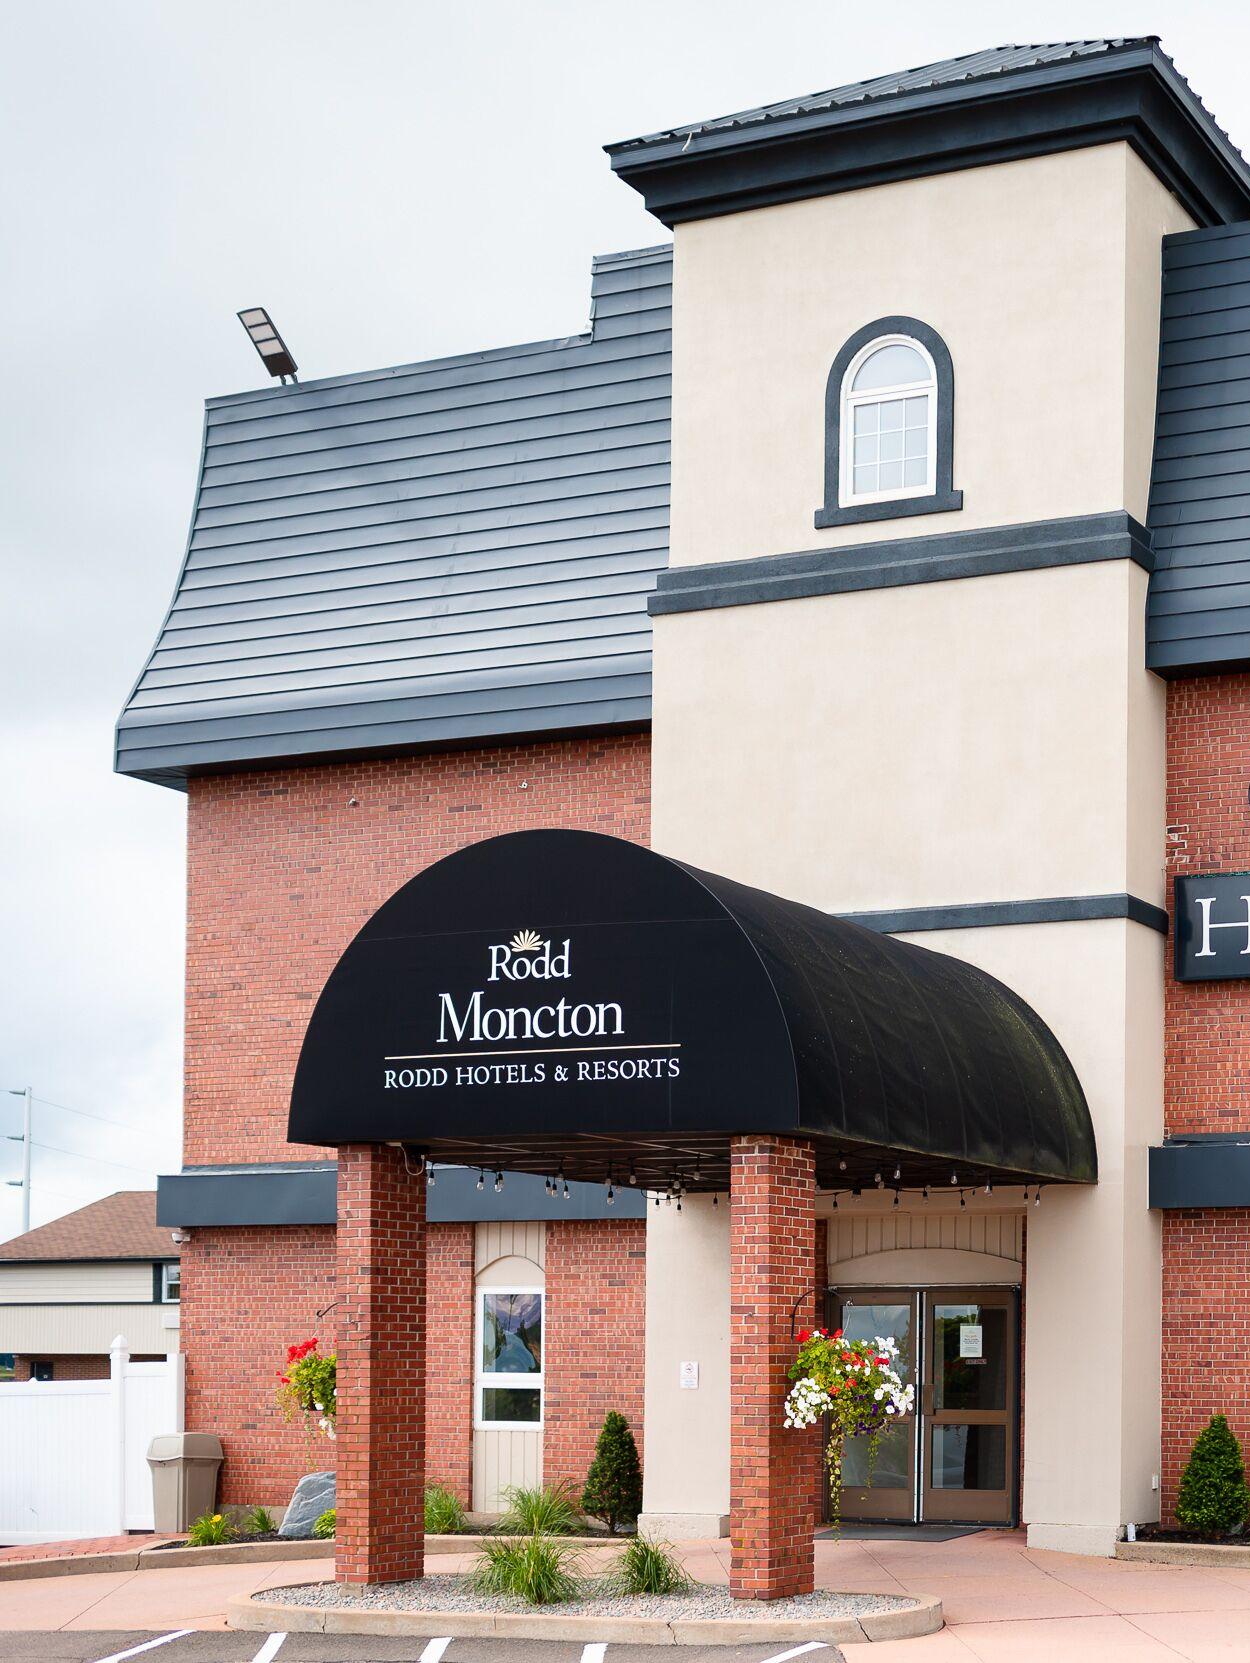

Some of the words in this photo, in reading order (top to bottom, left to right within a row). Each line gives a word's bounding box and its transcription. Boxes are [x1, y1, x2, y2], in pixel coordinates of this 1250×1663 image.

[487, 938, 572, 982] Rodd
[436, 990, 625, 1043] Moncton
[384, 1067, 448, 1089] RODD
[455, 1063, 546, 1086] HOTELS
[554, 1064, 569, 1082] &
[577, 1058, 681, 1081] RESORTS
